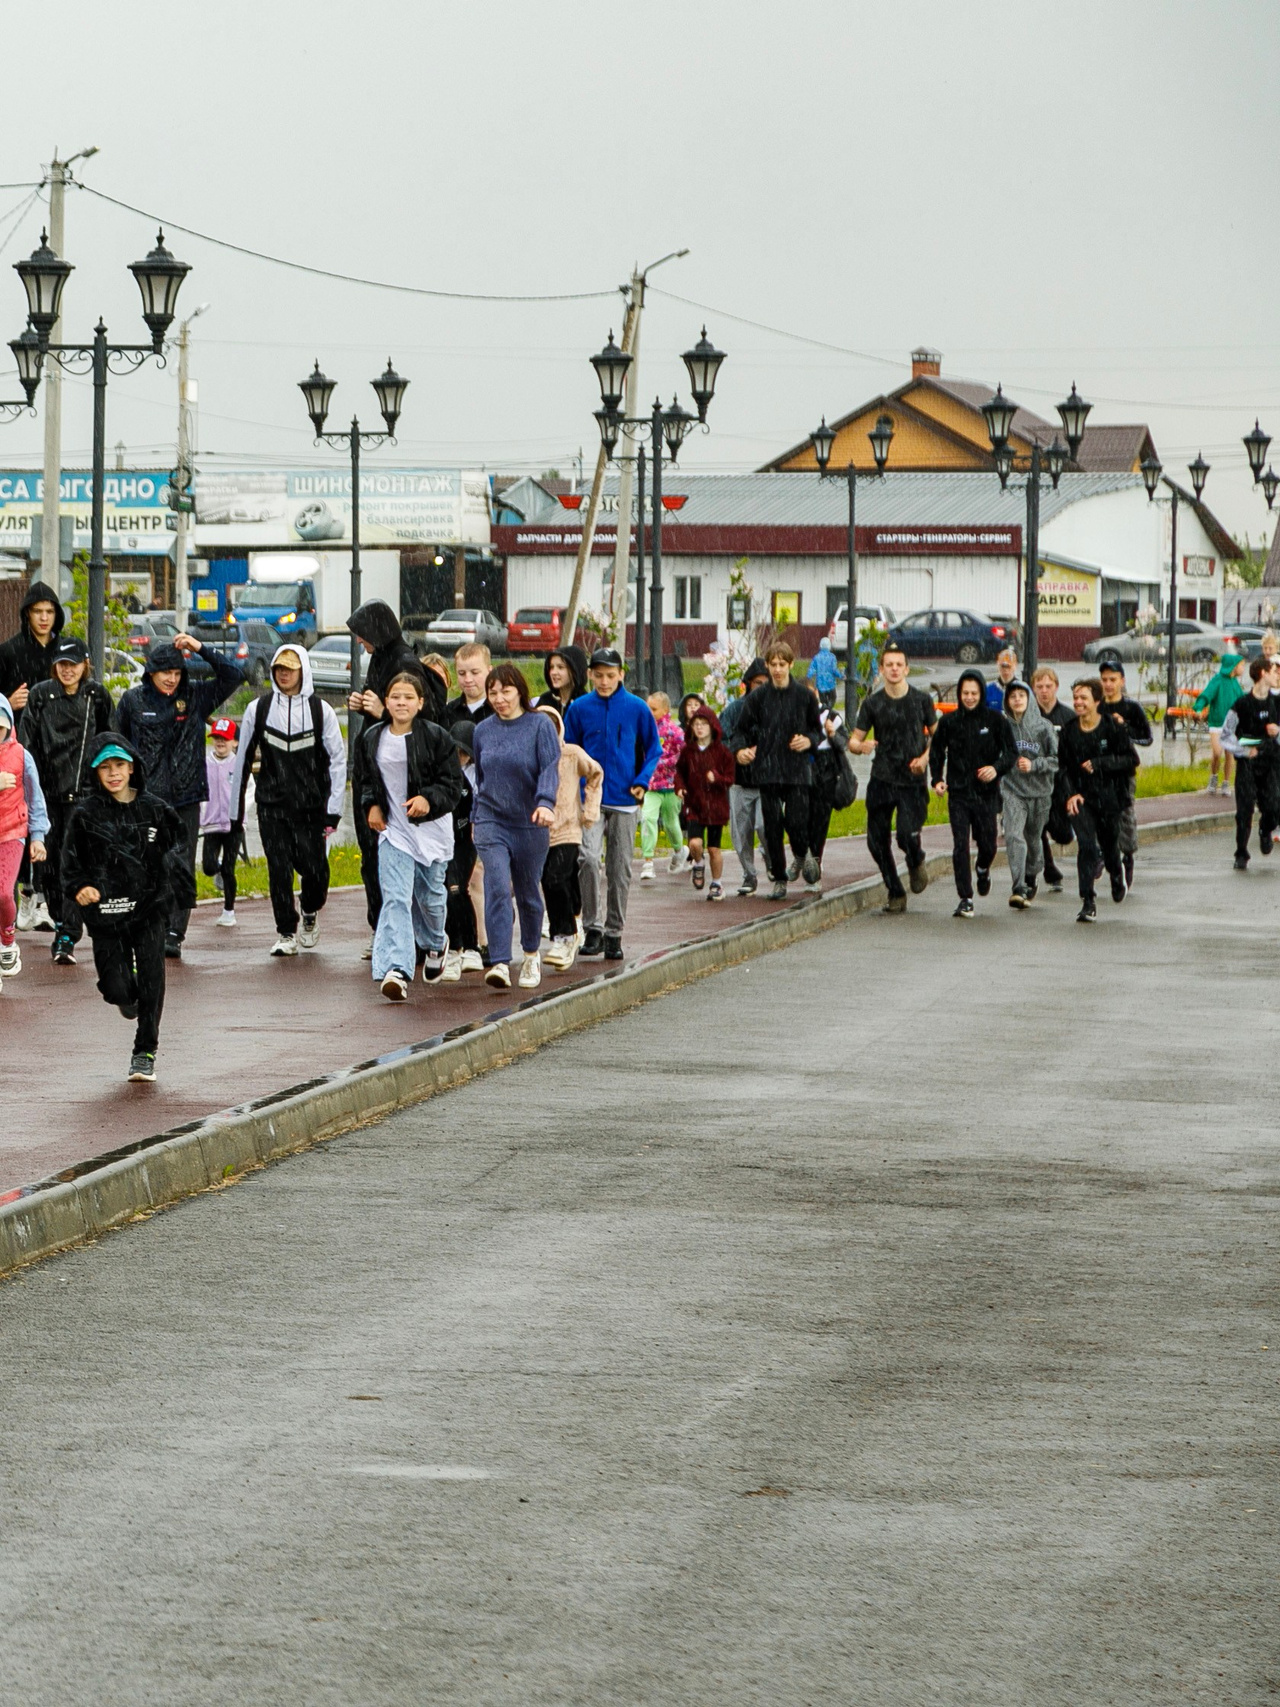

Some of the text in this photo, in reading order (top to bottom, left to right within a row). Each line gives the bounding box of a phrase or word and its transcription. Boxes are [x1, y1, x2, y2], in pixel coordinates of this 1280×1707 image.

[343, 502, 386, 513] рмонт
[107, 515, 161, 532] ЦЕНТР
[367, 513, 454, 526] балансировка
[396, 528, 454, 539] подкачка
[516, 533, 562, 545] ЗАПЧАСТИ
[1036, 582, 1090, 592] АПРАВКА
[1038, 594, 1077, 606] АВТО
